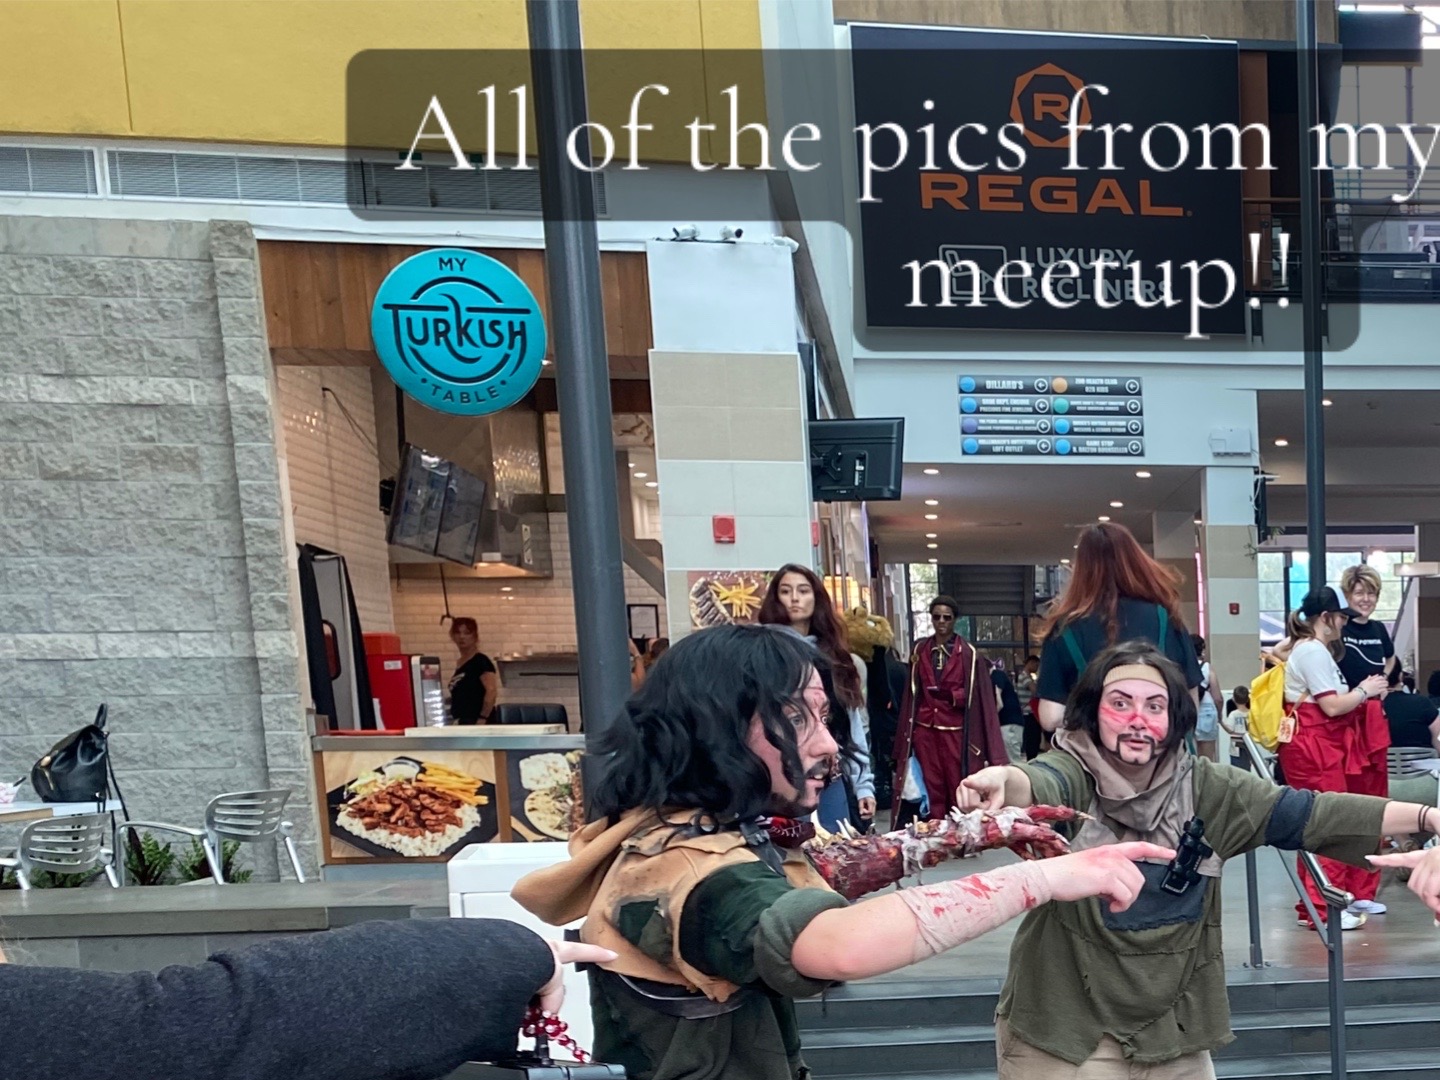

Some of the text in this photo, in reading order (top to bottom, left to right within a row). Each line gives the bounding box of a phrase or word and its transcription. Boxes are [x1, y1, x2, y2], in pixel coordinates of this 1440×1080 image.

[919, 172, 1185, 217] REGAL
[437, 257, 468, 272] MY
[1020, 246, 1134, 271] LUXURY
[430, 383, 500, 405] TABLE
[985, 379, 1024, 390] DILLARD'S
